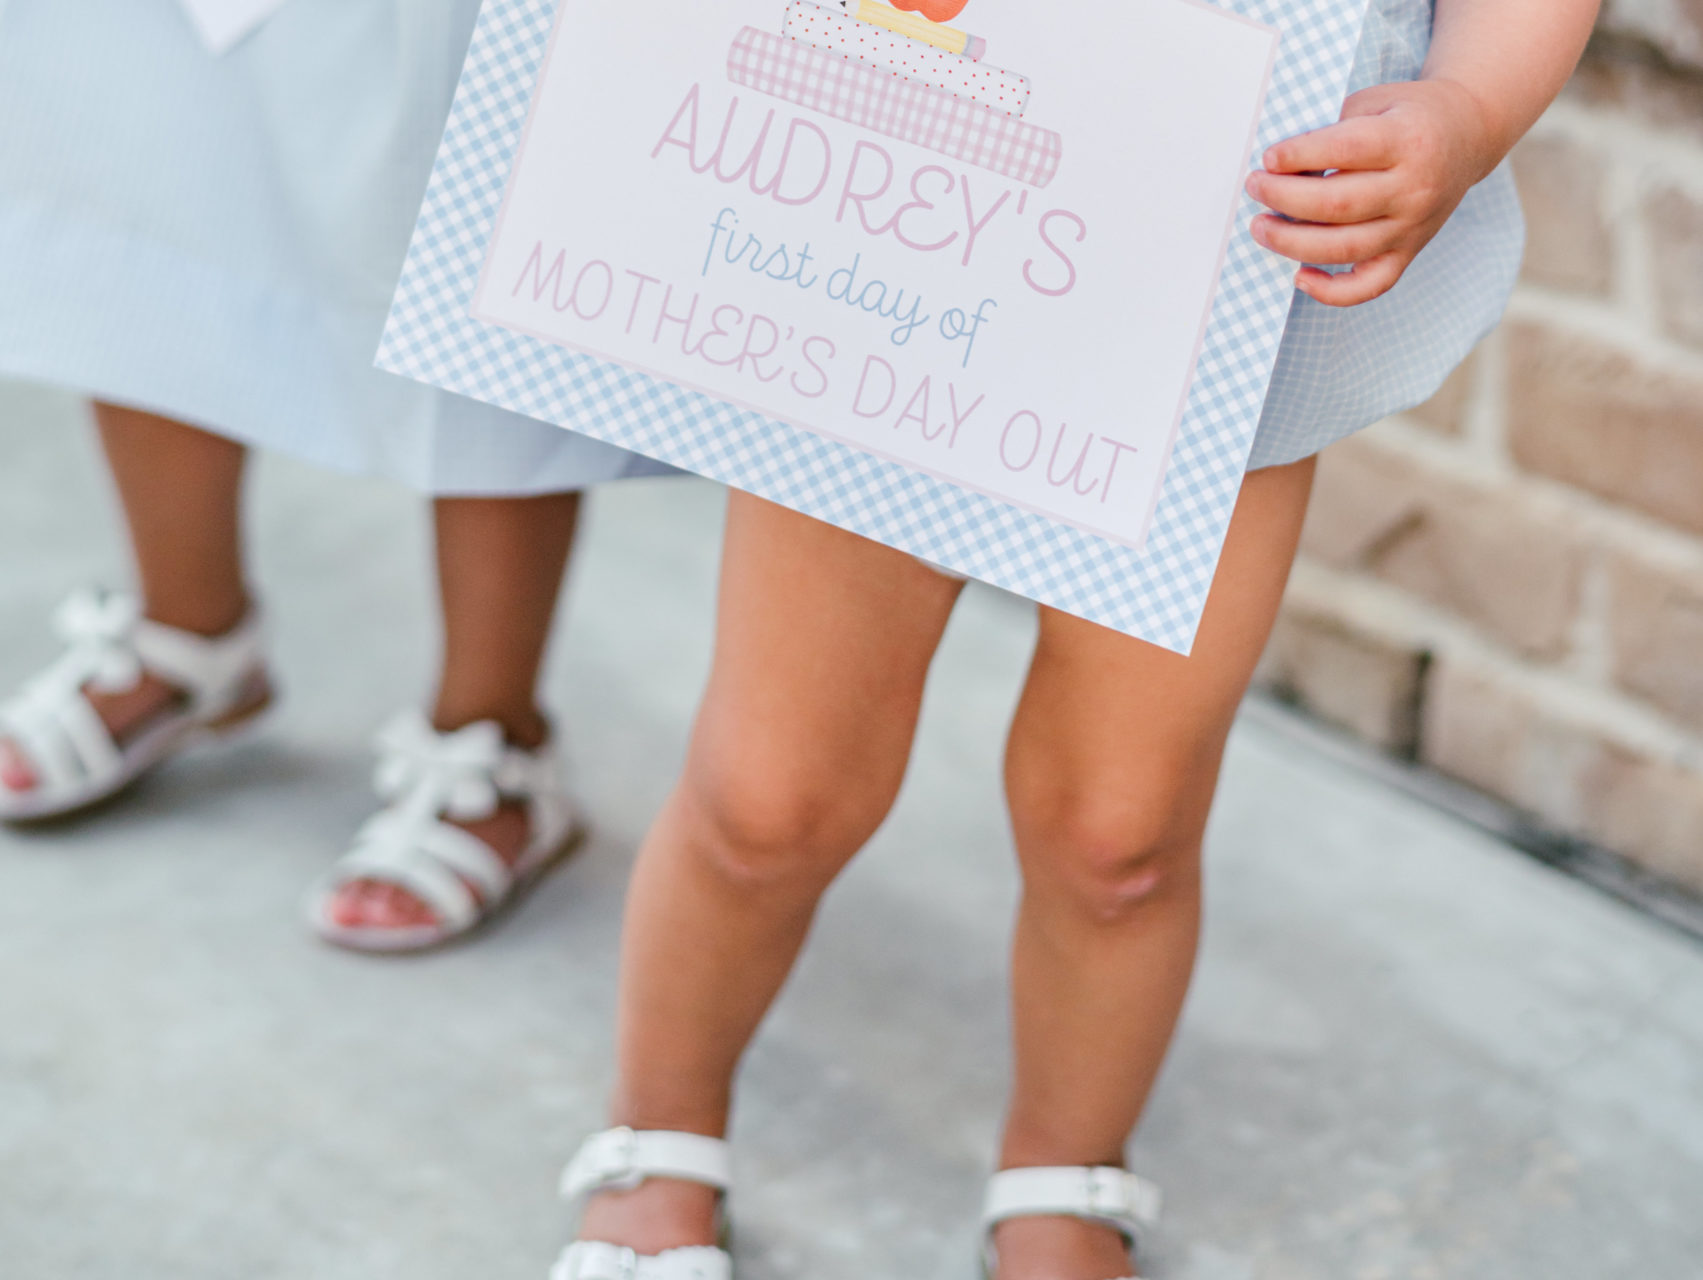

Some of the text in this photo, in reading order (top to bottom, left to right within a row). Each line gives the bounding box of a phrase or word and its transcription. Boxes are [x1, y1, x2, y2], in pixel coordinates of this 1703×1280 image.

[650, 81, 1087, 297] AUDREY'S
[701, 206, 998, 368] first day of
[511, 240, 1139, 503] MOTHER'S DAY OUT
